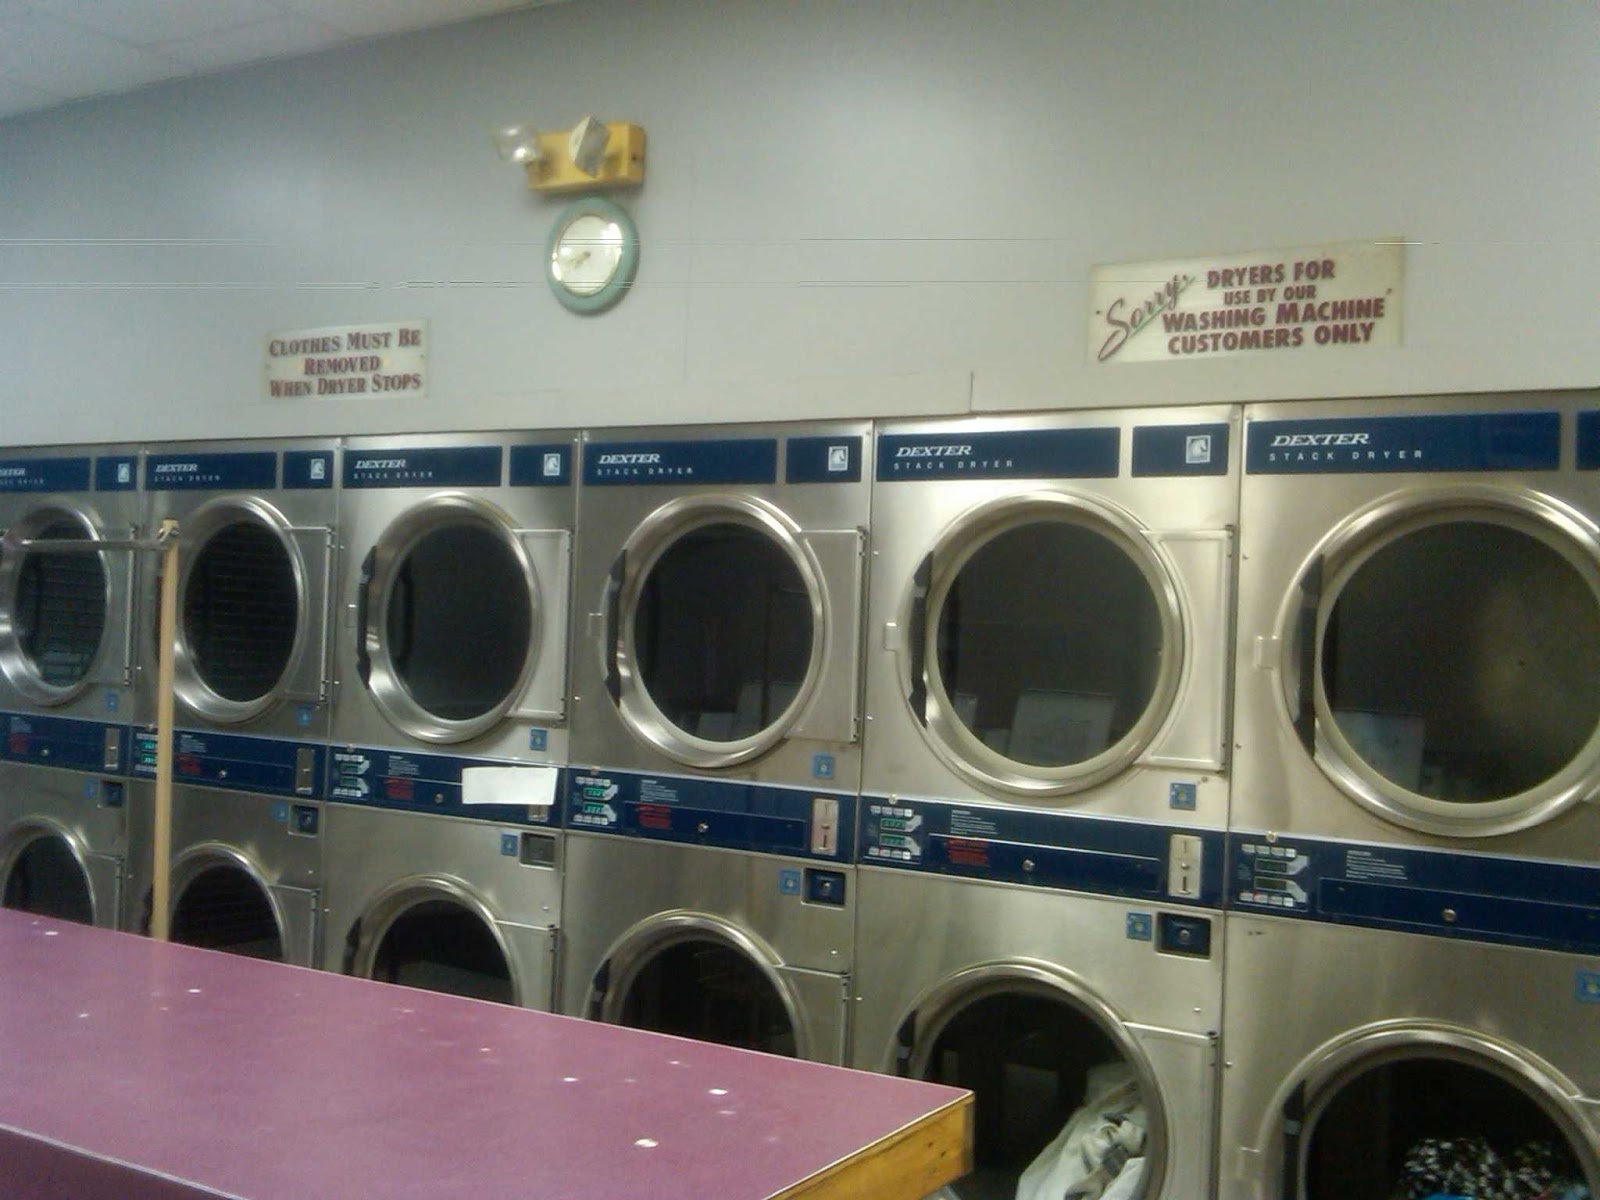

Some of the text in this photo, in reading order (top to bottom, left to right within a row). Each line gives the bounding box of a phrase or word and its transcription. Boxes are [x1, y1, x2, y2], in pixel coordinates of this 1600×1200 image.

[1207, 259, 1336, 289] DRYERS FOR
[1223, 284, 1317, 306] USE BY OUR
[1162, 298, 1385, 333] WASHING MACHINE
[269, 327, 422, 357] CLOTHES MUST BE
[1168, 322, 1376, 355] CUSTOMERS ONLY
[303, 355, 381, 375] REMOVED
[270, 373, 422, 397] WHEN DRYER STOPS
[1270, 432, 1370, 447] DEXTER
[598, 453, 661, 465] DEXTER
[895, 445, 972, 458] DEXTER
[1269, 449, 1423, 462] STACK DRYER
[355, 459, 406, 469] DEXTER
[894, 459, 1013, 471] STACK DRYER
